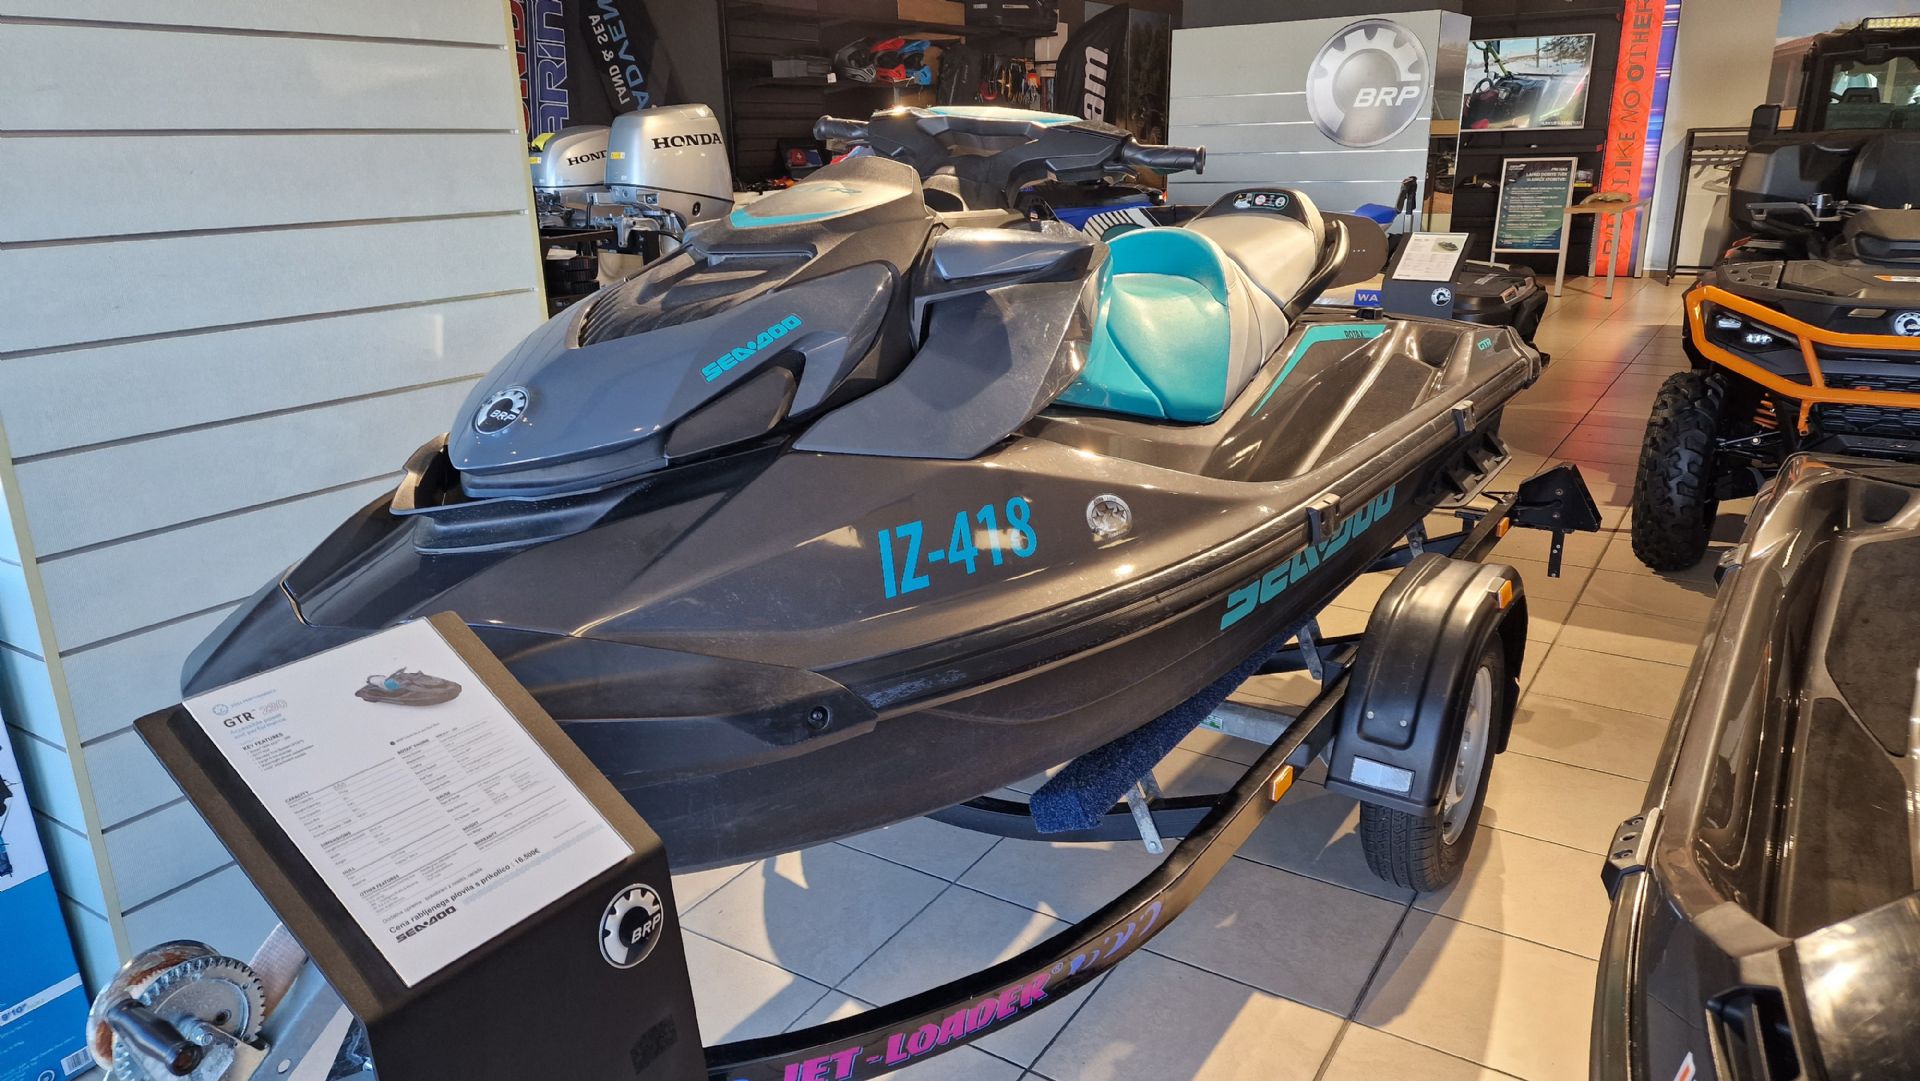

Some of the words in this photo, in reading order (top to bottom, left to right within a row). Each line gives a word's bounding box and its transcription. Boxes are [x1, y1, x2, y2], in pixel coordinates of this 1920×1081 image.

[1353, 85, 1421, 108] BRP
[1619, 90, 1641, 125] NO
[652, 132, 723, 150] HONDA
[1613, 131, 1636, 188] LIKE
[490, 409, 517, 421] BRP
[877, 496, 1038, 599] IZ-418
[223, 711, 255, 728] GTR
[389, 920, 410, 934] Cena
[411, 899, 450, 922] rabljenega
[450, 885, 475, 902] plovila
[631, 912, 661, 945] BRP
